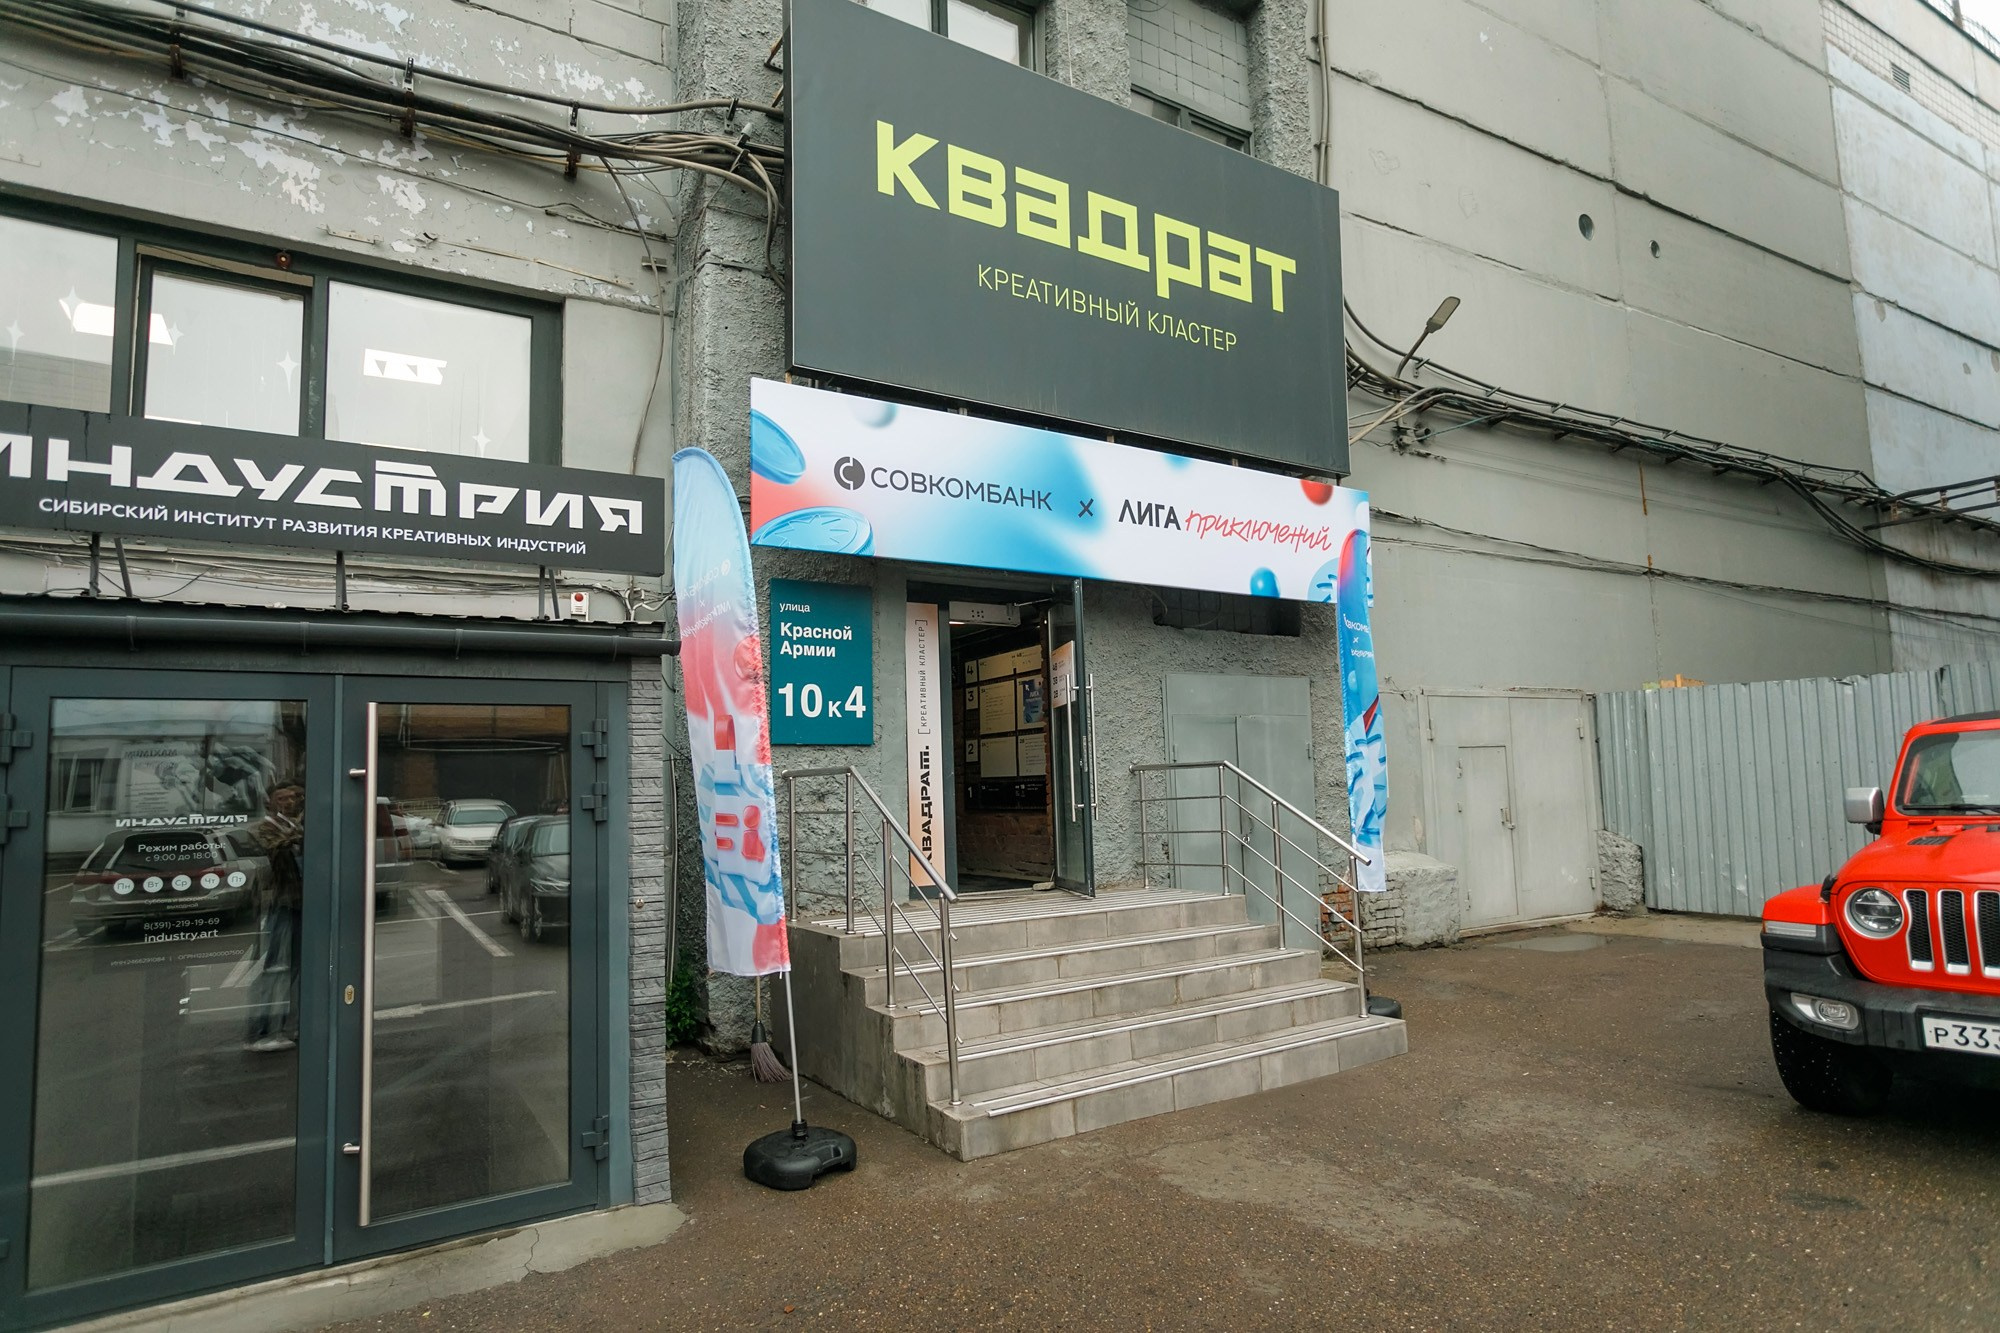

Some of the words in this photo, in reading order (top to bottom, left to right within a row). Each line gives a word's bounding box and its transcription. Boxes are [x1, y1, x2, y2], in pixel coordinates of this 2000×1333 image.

[978, 264, 1140, 328] КРЕАТИВНЫЙ
[1147, 310, 1238, 352] КЛАСТЕР
[871, 466, 1053, 512] СОВКОМБАНК
[1118, 498, 1182, 531] ЛИГА
[1185, 508, 1332, 553] приключений
[38, 497, 168, 522] СИБИРСКИЙ
[173, 508, 276, 531] ИНСТИТУТ
[281, 518, 379, 539] РАЗВИТИЯ
[381, 527, 492, 548] КРЕАТИВНЫХ
[496, 536, 587, 555] ИНДУСТРИЙ
[779, 602, 811, 613] улица
[780, 621, 853, 641] Красной
[779, 640, 836, 659] Армии
[115, 813, 248, 828] ИНДУСТРИЯ
[137, 843, 177, 853] Режим
[180, 841, 226, 853] работы:
[153, 853, 176, 862] 9:00
[178, 853, 191, 862] до
[193, 851, 218, 860] 18:00
[175, 879, 187, 888] Ср
[143, 917, 220, 931] 8(391)-219-19-69
[144, 928, 219, 943] industry.art
